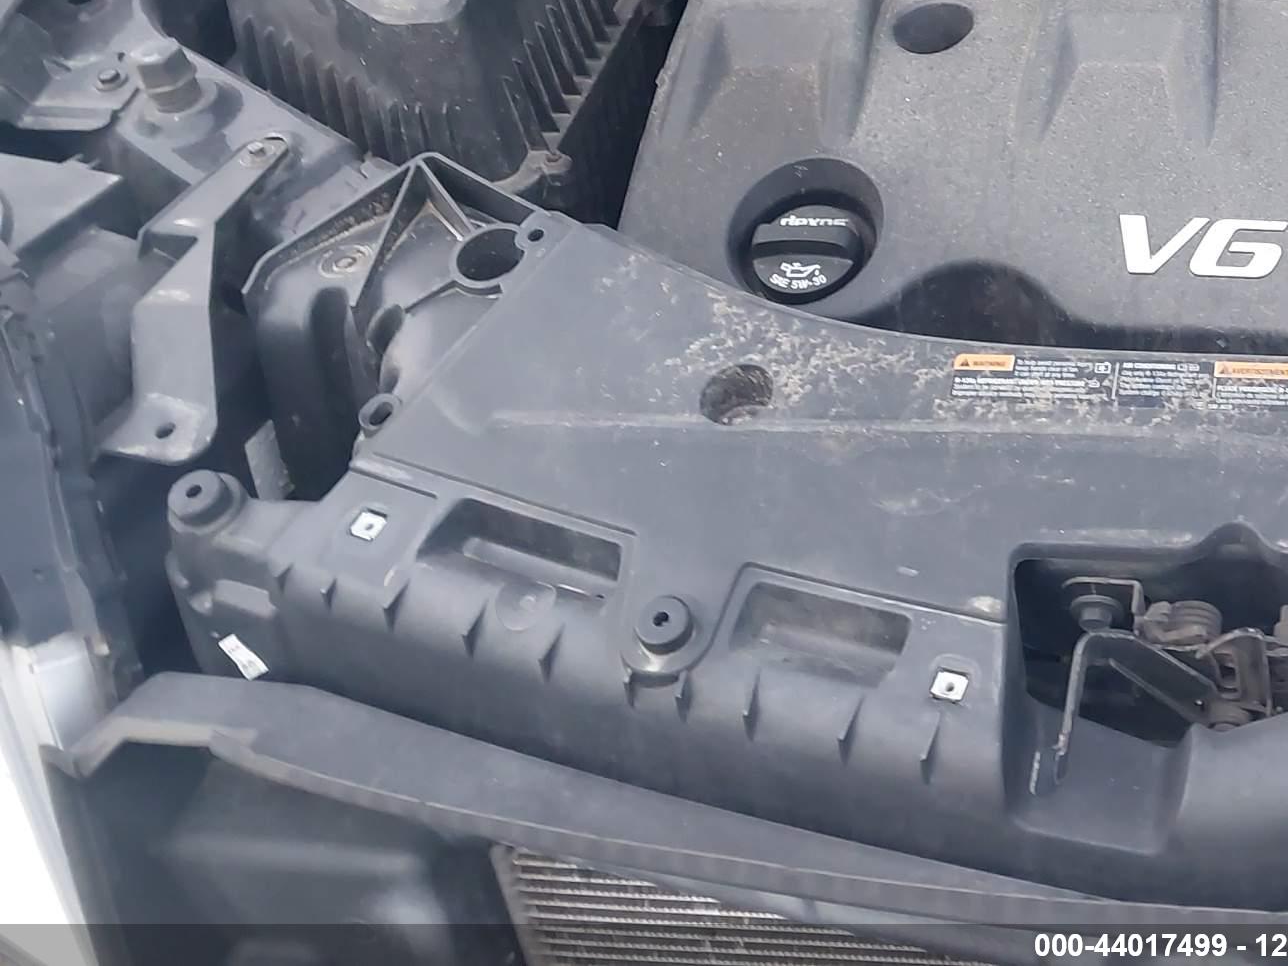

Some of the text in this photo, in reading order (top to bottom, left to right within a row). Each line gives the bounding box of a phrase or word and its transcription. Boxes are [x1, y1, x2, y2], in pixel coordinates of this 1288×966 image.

[1119, 214, 1288, 278] V6
[769, 273, 828, 290] SAE 5W-30
